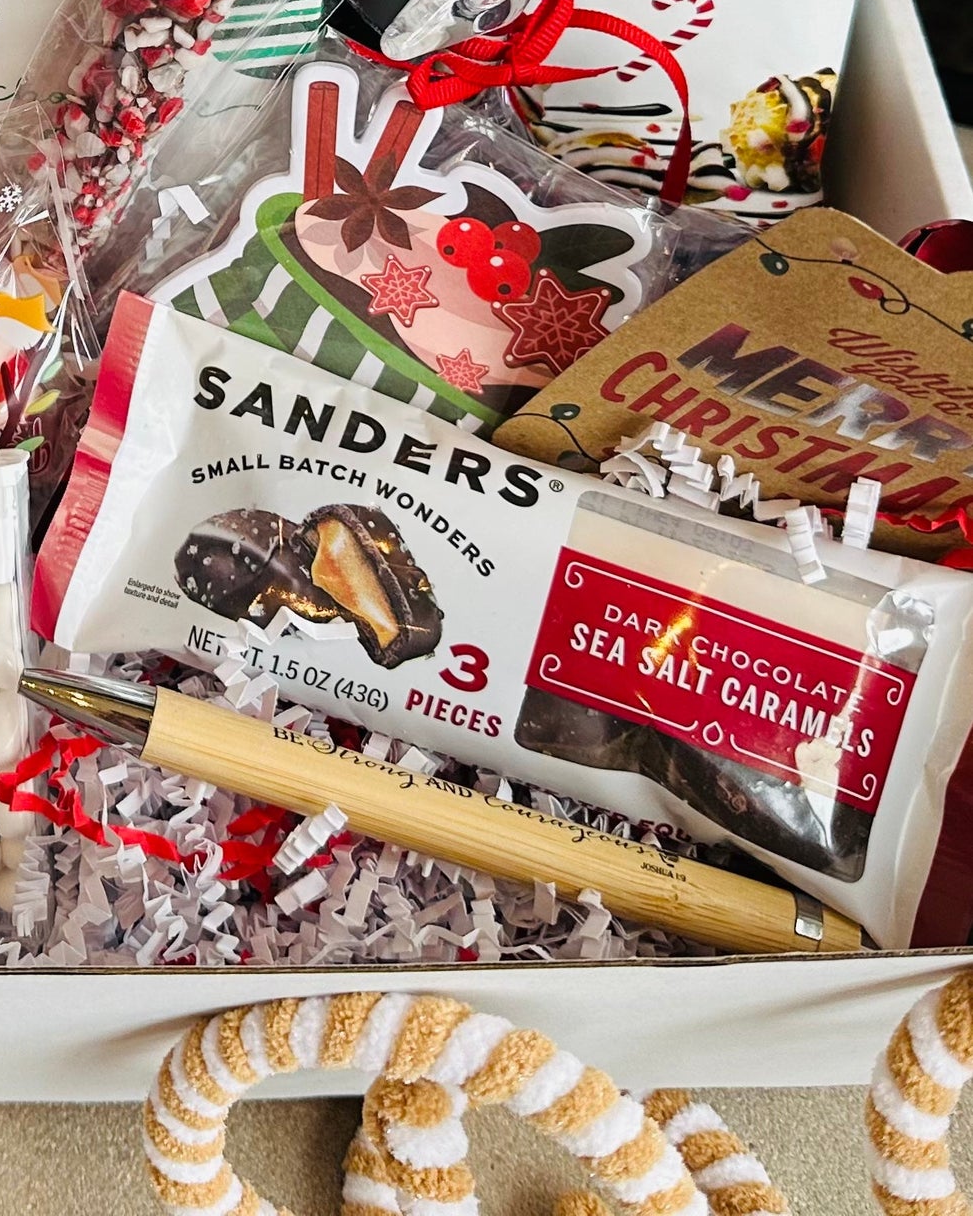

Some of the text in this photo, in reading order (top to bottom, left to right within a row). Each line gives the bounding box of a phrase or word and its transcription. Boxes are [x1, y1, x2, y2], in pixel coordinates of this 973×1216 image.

[677, 322, 973, 479] MERR
[841, 363, 931, 400] you
[192, 365, 545, 509] SANDERS
[599, 350, 973, 516] CHRISTMA
[190, 453, 496, 579] SMALL BATCH WONDERS
[128, 578, 155, 592] Enlarged
[162, 589, 181, 600] show
[147, 594, 159, 603] and
[159, 597, 179, 609] detail
[187, 625, 227, 656] NET
[269, 654, 299, 680] 1.5
[303, 666, 331, 690] OZ
[334, 677, 389, 712] (43G)
[438, 643, 490, 693] 3
[569, 622, 875, 759] SEA SALT CARAMELS
[603, 603, 865, 714] DARK CHOCOLATE
[405, 687, 502, 739] PIECES
[273, 726, 304, 747] BE
[299, 732, 417, 789] Strong
[425, 776, 473, 799] AND
[640, 862, 675, 880] JOSHUA
